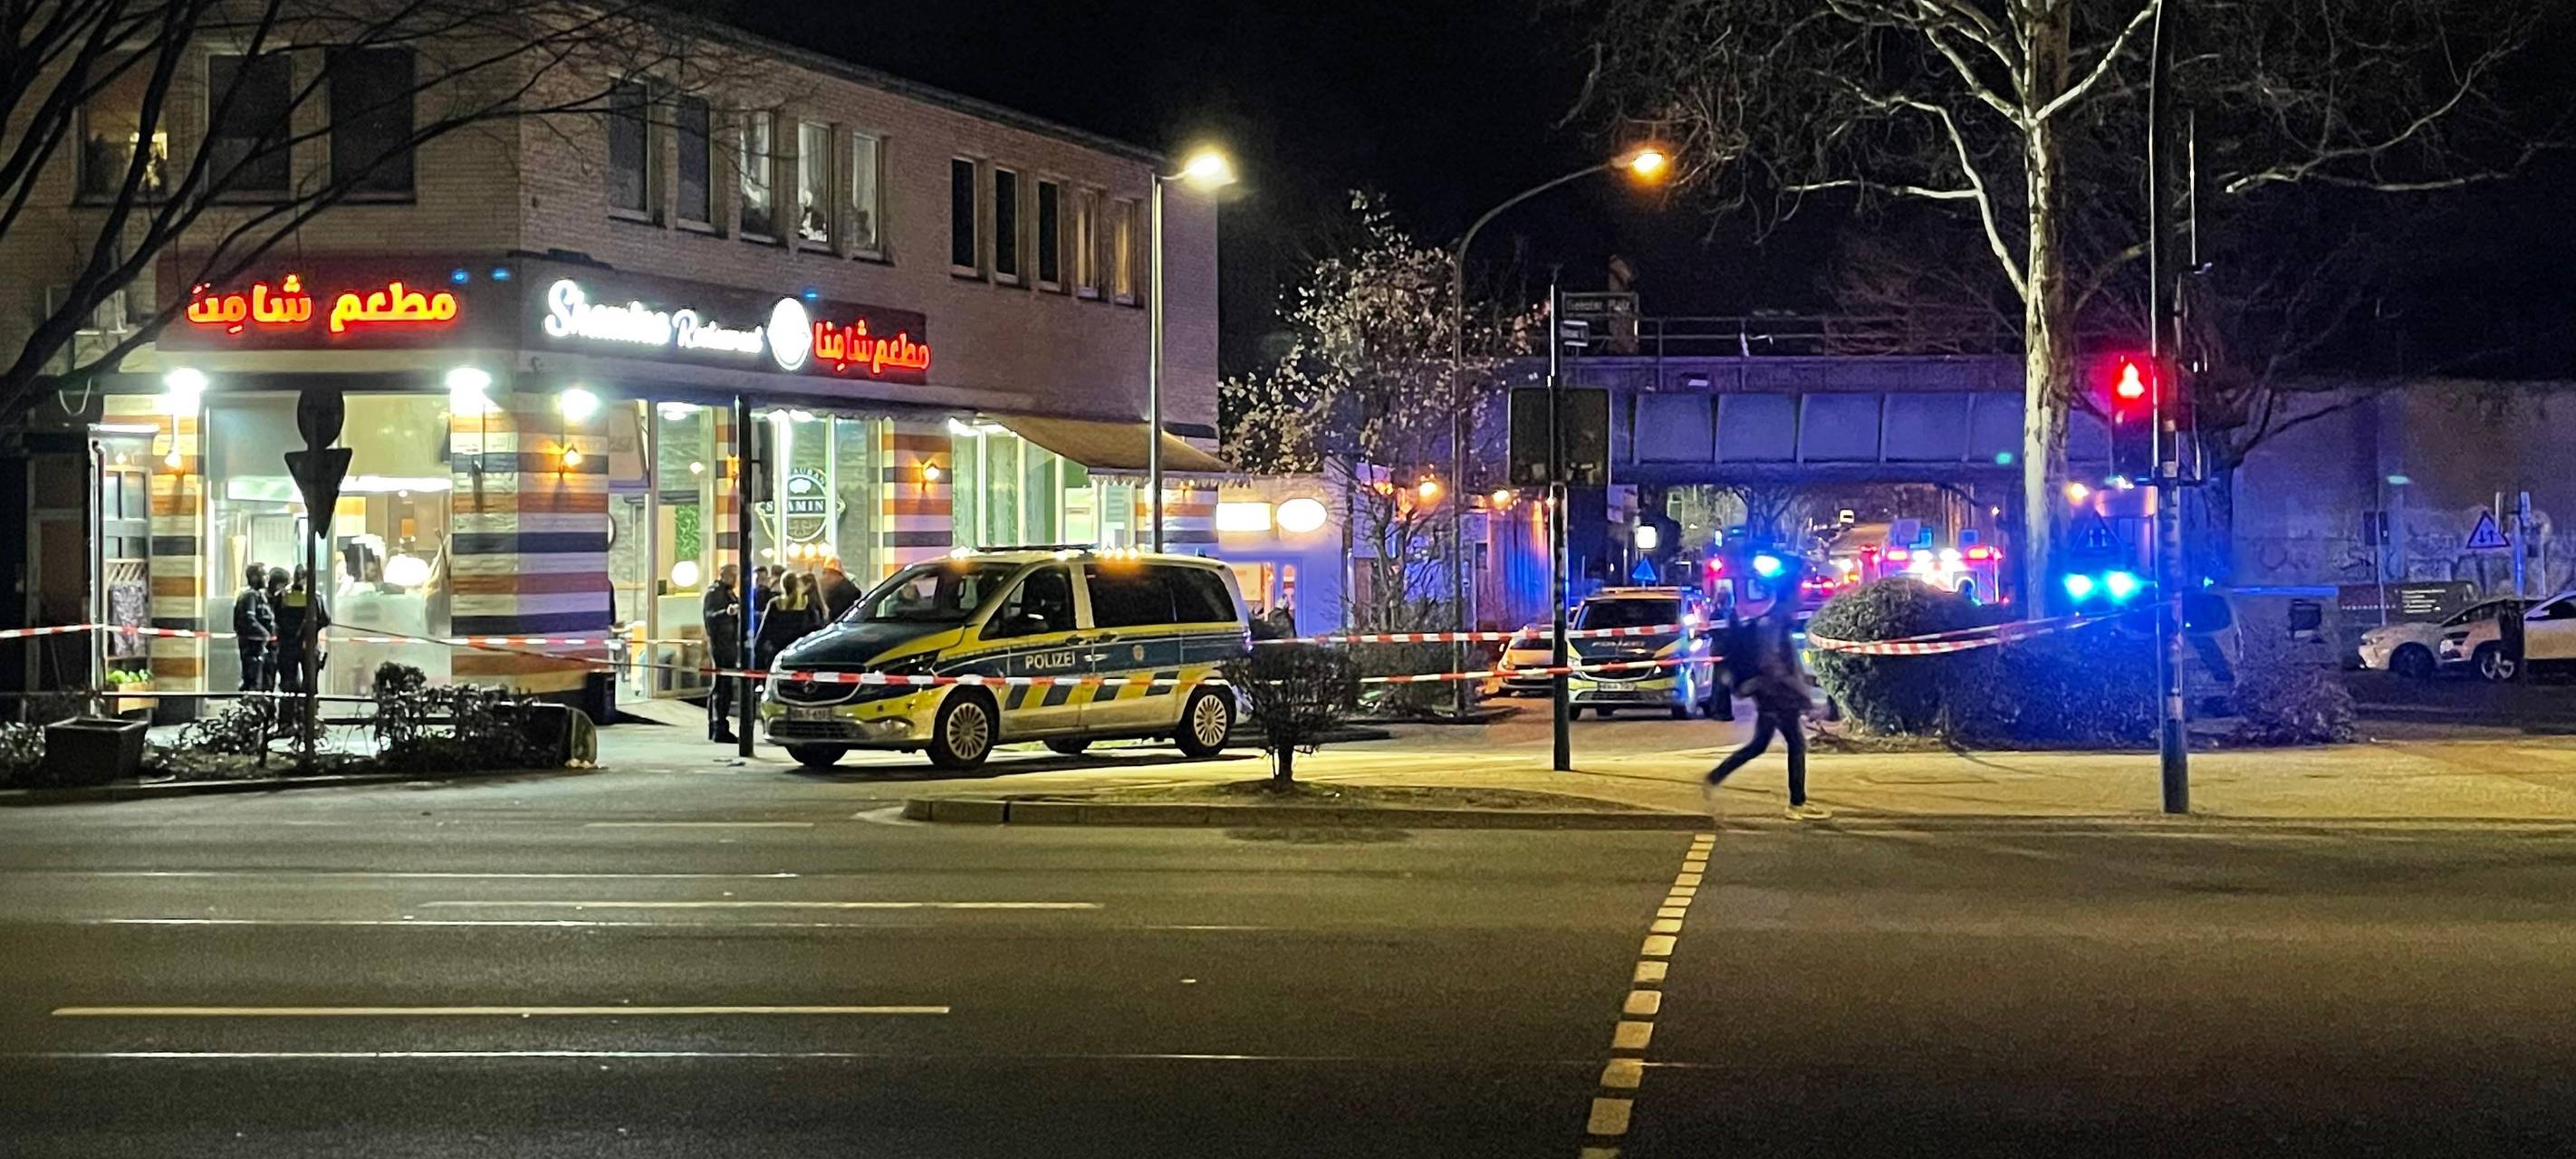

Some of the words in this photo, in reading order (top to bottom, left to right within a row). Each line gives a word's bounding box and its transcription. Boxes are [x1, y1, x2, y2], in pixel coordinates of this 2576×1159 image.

[330, 282, 457, 333] مطعم
[872, 332, 930, 374] مطعم
[1024, 650, 1076, 670] POLIZEI
